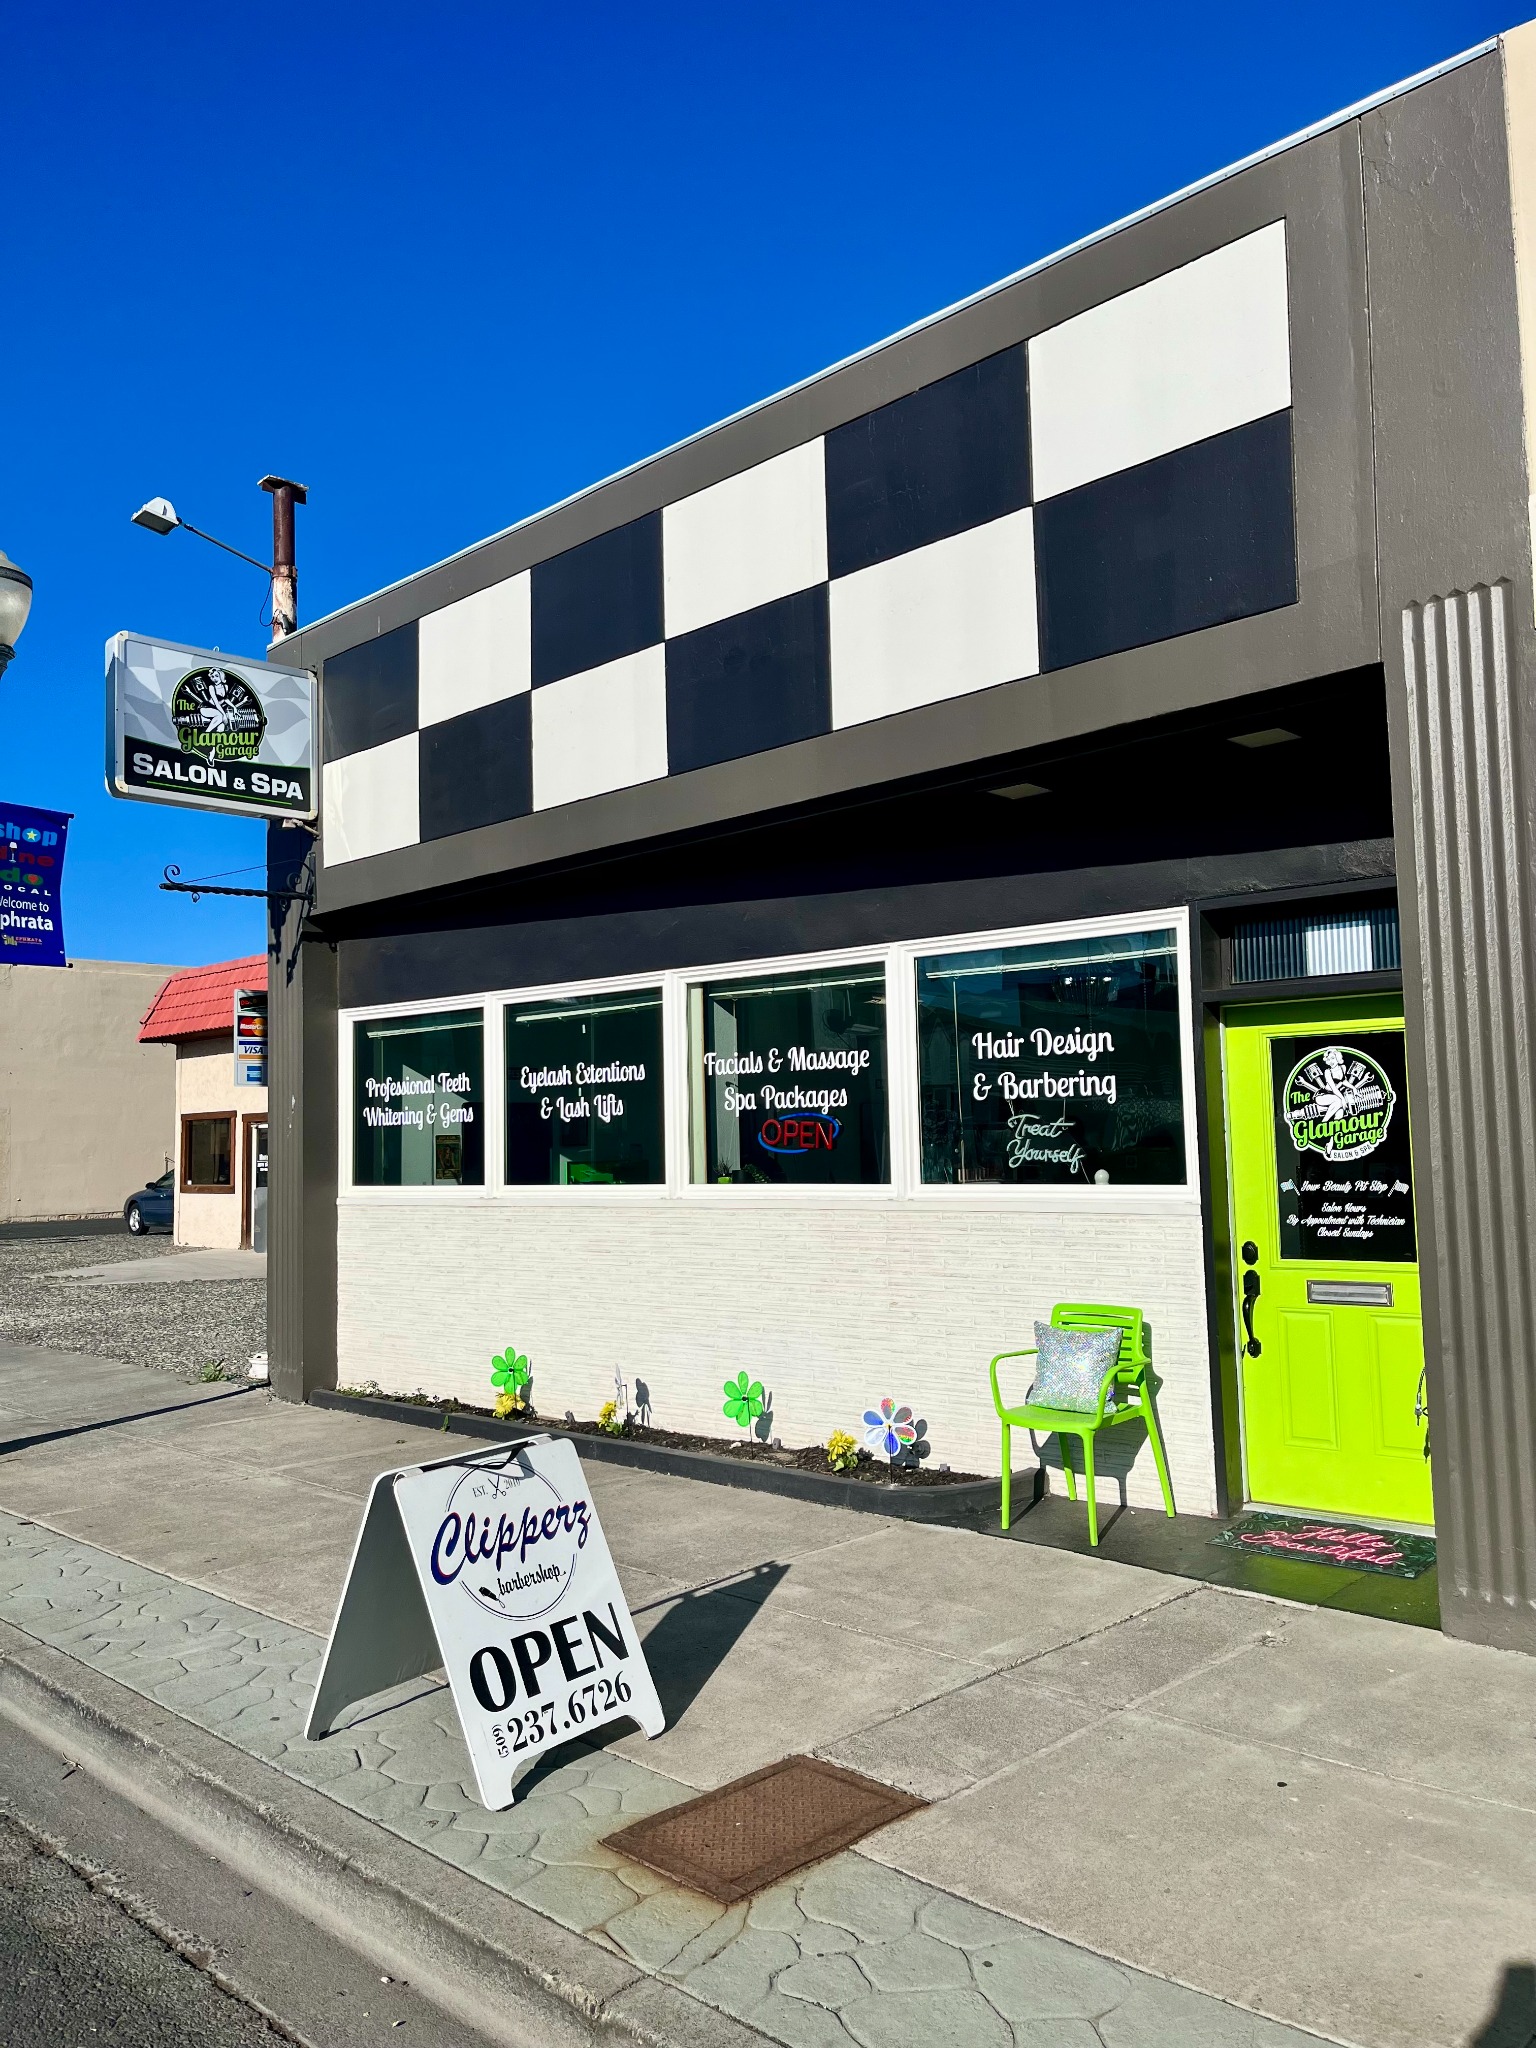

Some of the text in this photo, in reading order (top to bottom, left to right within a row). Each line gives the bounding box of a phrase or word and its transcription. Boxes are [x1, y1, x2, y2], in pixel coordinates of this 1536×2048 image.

[176, 699, 196, 711] The
[178, 727, 259, 752] Glamour
[215, 743, 259, 760] Garage
[133, 752, 304, 800] SALON & SPA
[0, 884, 52, 897] OCAL
[0, 910, 54, 931] phrata
[39, 901, 50, 913] to
[243, 1046, 264, 1055] VISA
[972, 1026, 1115, 1062] Hair Design
[703, 1046, 870, 1076] Facials & Massage
[366, 1072, 471, 1103] Professional Teeth
[520, 1060, 646, 1094] Eyelash Extentions
[973, 1069, 1117, 1105] & Barbering
[540, 1093, 624, 1123] & Lash Lifts
[724, 1085, 848, 1117] Spa Packages
[1290, 1091, 1311, 1105] The
[363, 1102, 474, 1131] Whitening & Gems
[1008, 1113, 1076, 1140] Treat
[1293, 1111, 1384, 1147] Glamour
[761, 1119, 833, 1150] OPEN
[1333, 1127, 1383, 1149] Garage
[1006, 1139, 1087, 1174] Yourself
[1333, 1144, 1373, 1159] SALON & SPA
[1300, 1180, 1389, 1194] Your Beauty Pit Stop
[1286, 1213, 1406, 1227] By Appointment with Technician
[1321, 1202, 1367, 1213] Salon Hours
[1317, 1226, 1374, 1240] Closed Sundays
[472, 1485, 489, 1498] EST.
[431, 1500, 592, 1586] Clipperz
[1240, 1530, 1404, 1566] Beautiful
[1290, 1525, 1395, 1549] Hello
[497, 1564, 566, 1596] barbershop
[469, 1602, 631, 1713] OPEN
[507, 1671, 633, 1752] 237.6726
